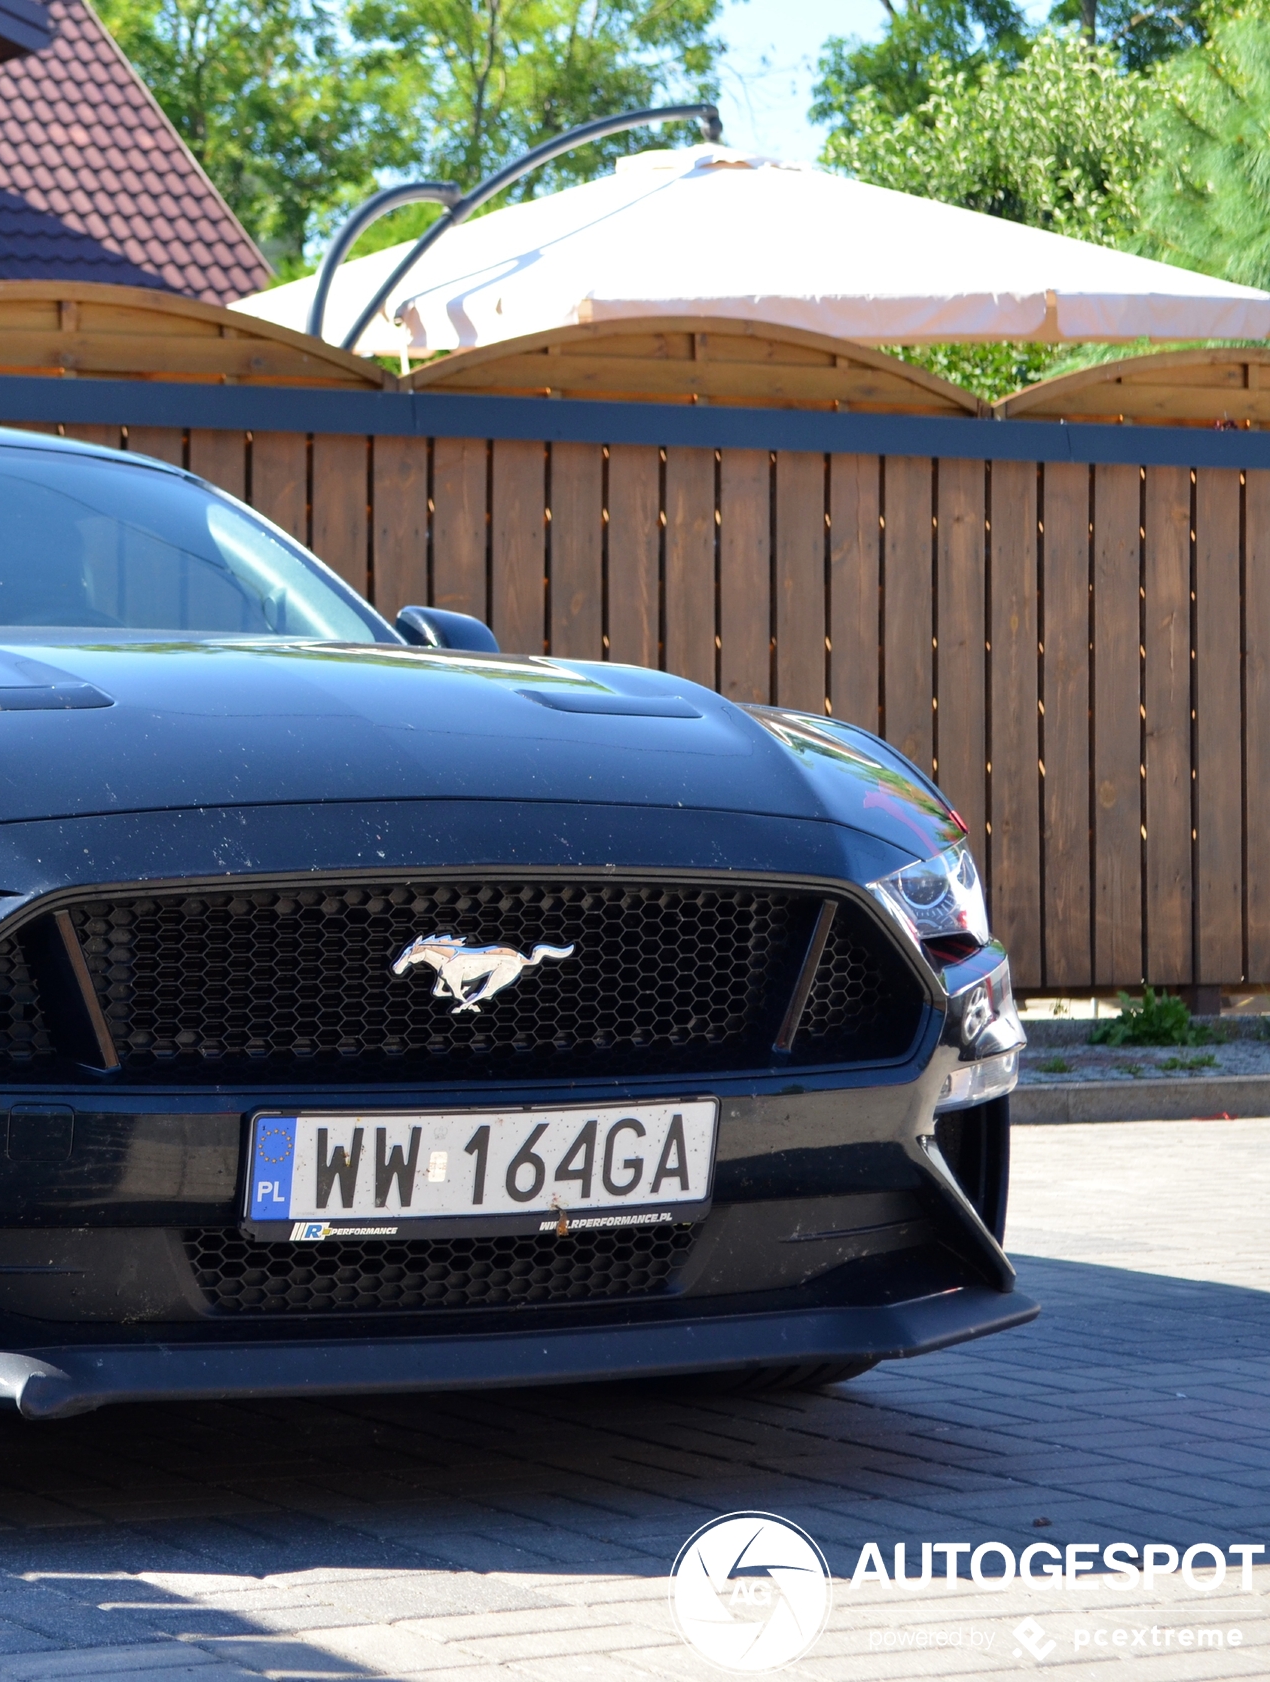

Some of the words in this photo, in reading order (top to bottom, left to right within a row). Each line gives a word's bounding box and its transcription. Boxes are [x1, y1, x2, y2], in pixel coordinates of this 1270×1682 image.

[316, 1126, 422, 1209] WW
[463, 1114, 690, 1206] 164GA
[257, 1181, 285, 1202] PL
[304, 1224, 323, 1239] R
[539, 1212, 673, 1231] WW.RPERFORMANCE.PL
